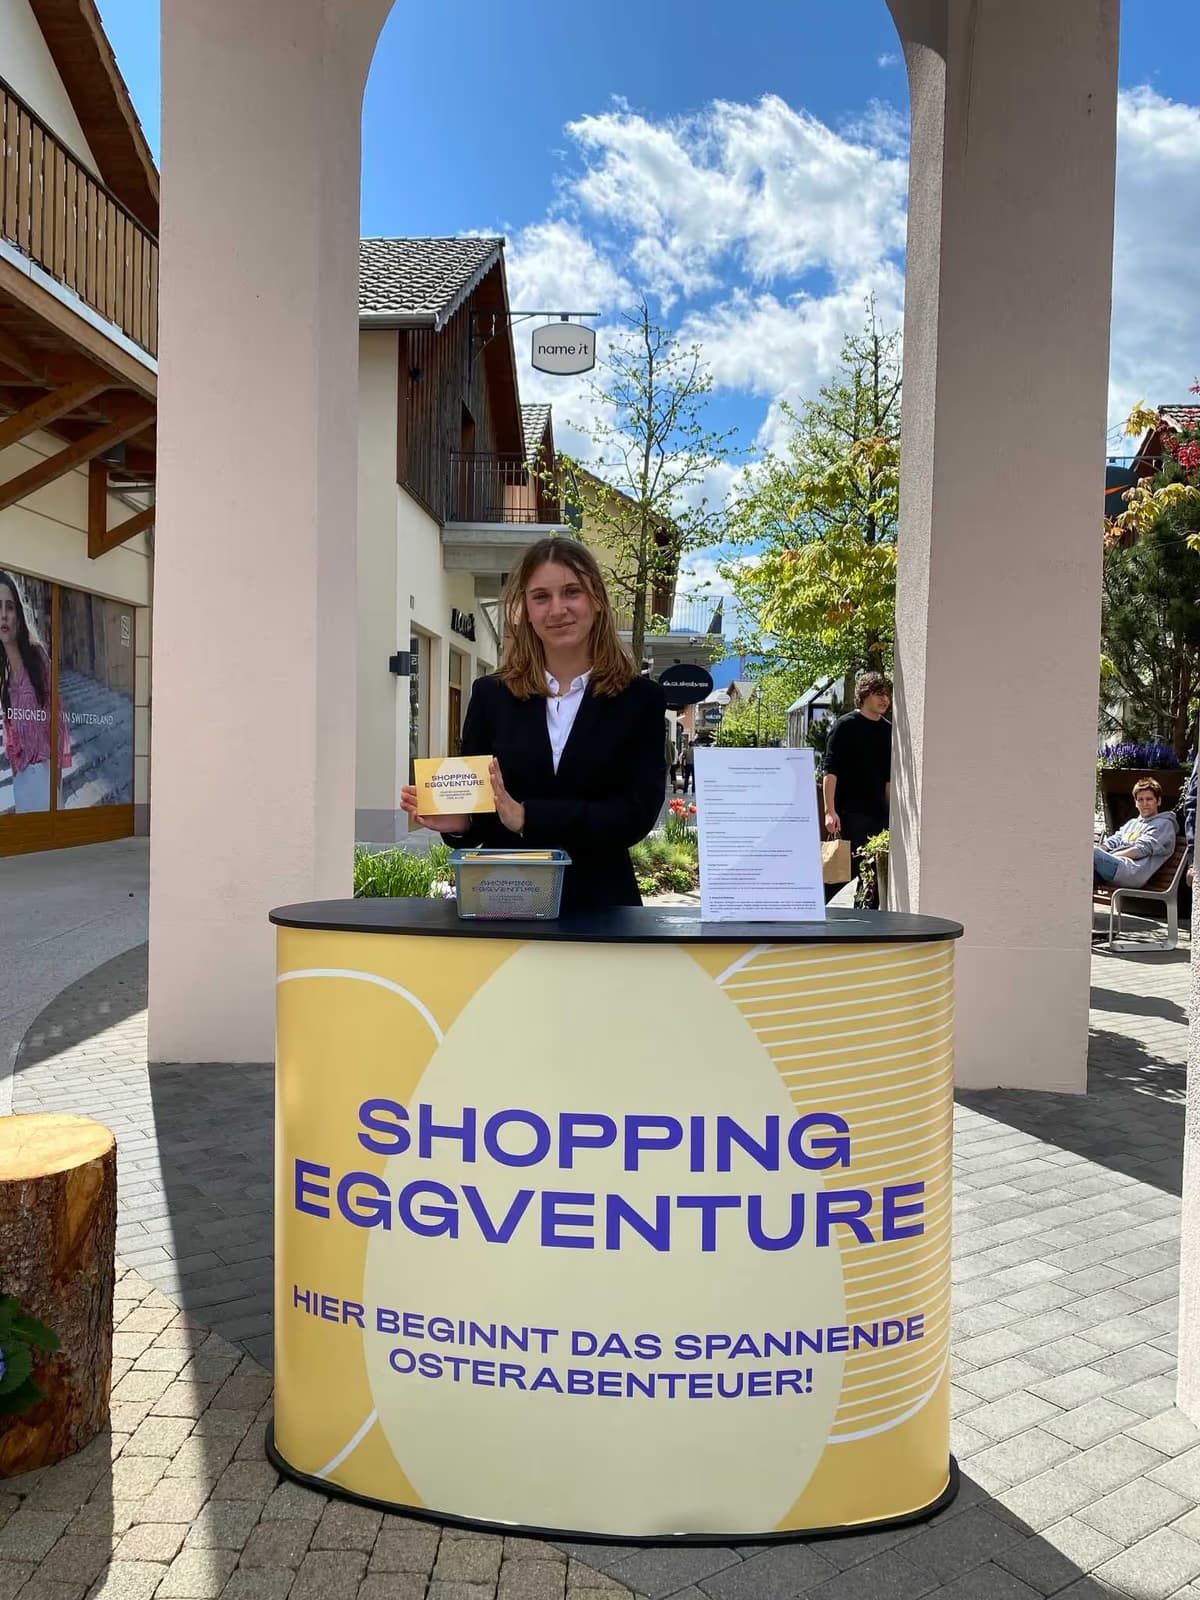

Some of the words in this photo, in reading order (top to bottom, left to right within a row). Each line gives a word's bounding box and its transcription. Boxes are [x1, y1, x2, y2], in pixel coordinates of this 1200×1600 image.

[538, 343, 575, 355] name
[578, 343, 588, 355] it
[7, 707, 47, 722] DESIGNED
[62, 711, 71, 723] IN
[71, 712, 114, 726] SWITZERLAND
[424, 779, 485, 788] EGGVENTURE
[357, 1098, 852, 1173] SHOPPING
[295, 1158, 926, 1253] EGGVENTURE
[292, 1284, 366, 1329] HIER
[375, 1307, 559, 1354] BEGINNT
[570, 1330, 663, 1360] DAS
[674, 1314, 926, 1361] SPANNENDE
[388, 1347, 815, 1399] OSTERABENTEUER!
